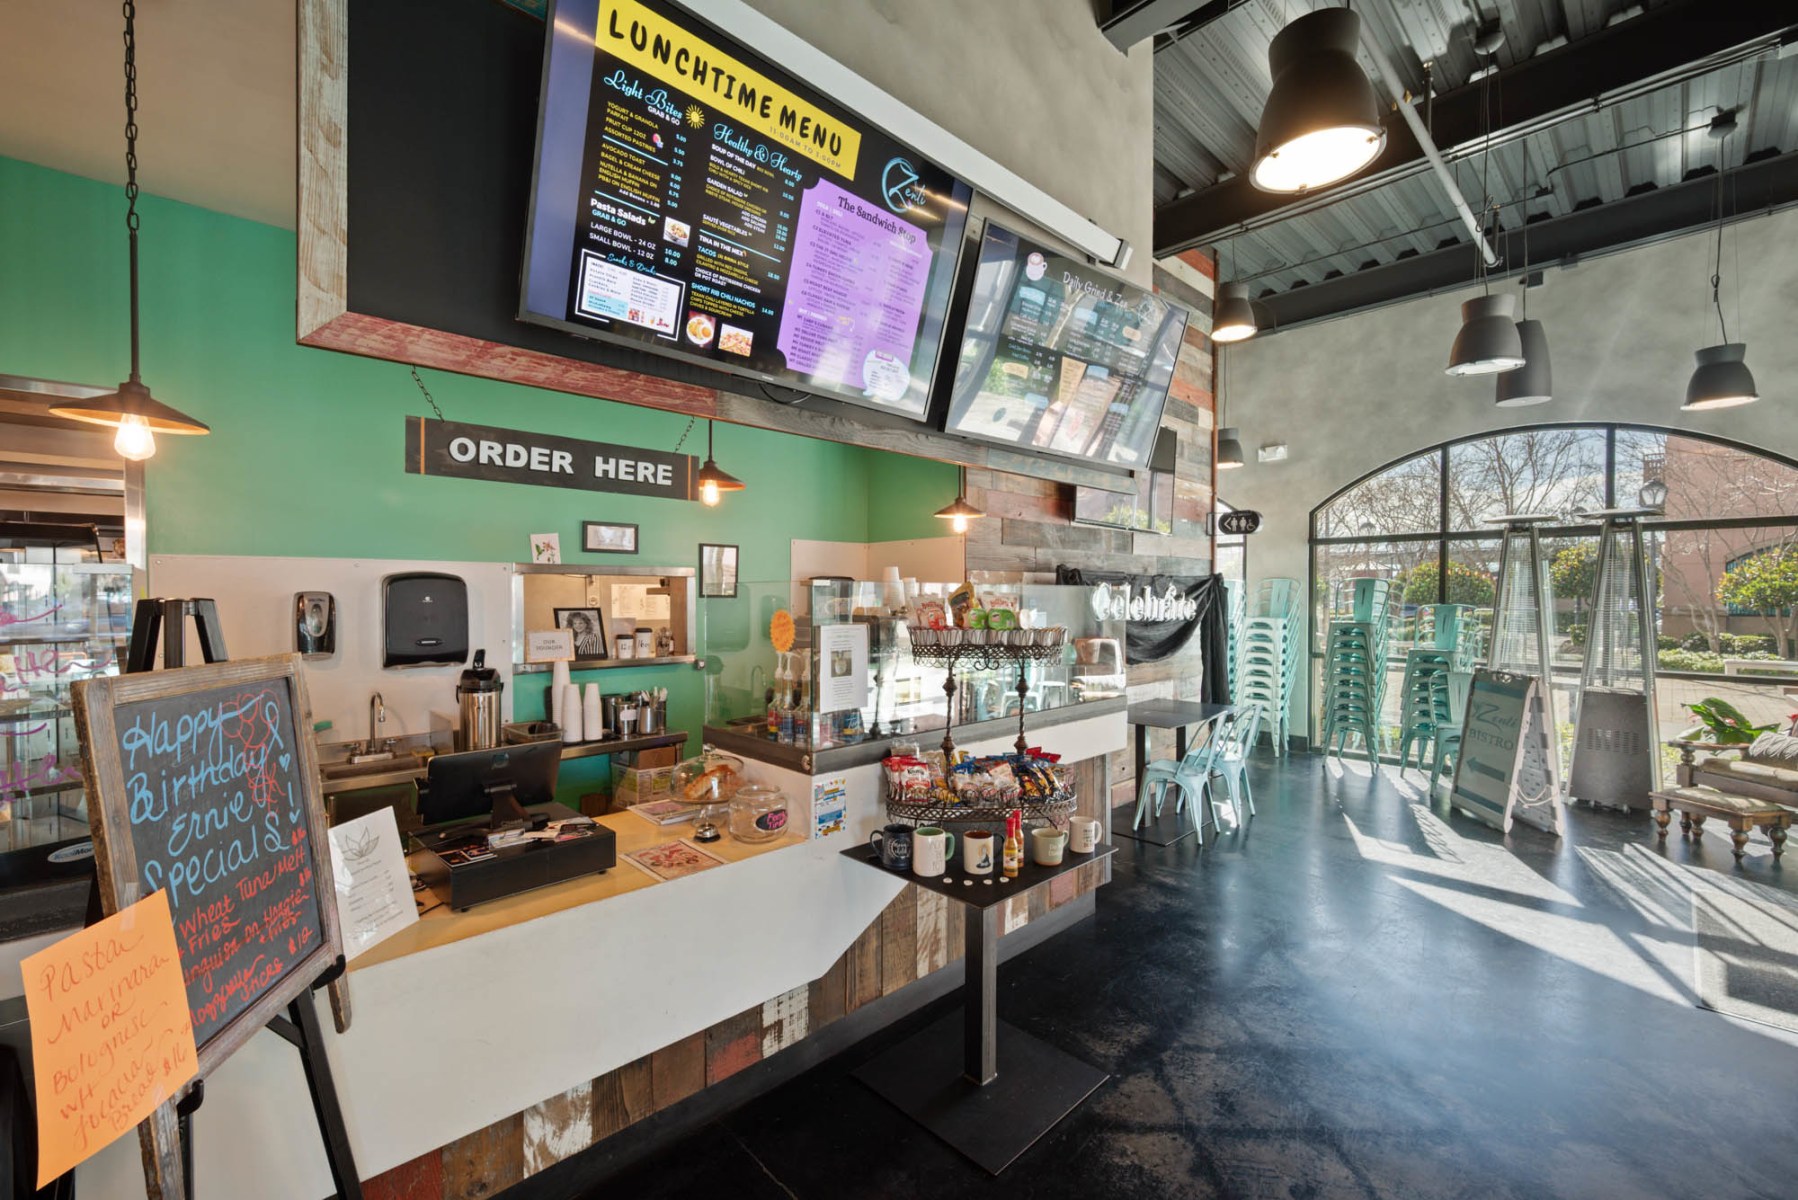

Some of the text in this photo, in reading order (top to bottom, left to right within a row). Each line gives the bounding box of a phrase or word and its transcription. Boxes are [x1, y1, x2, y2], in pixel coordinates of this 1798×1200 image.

[604, 69, 683, 119] Light Bites
[609, 9, 842, 157] LUNCHTIME MENU
[606, 117, 621, 128] FRUIT
[622, 124, 632, 133] CUP
[607, 108, 629, 122] PARFAIT
[608, 101, 629, 116] YOGURT
[635, 114, 658, 129] GRANOLA
[648, 105, 665, 118] GRAB
[671, 117, 680, 126] GO
[604, 126, 656, 153] ASSORTED PASTRIES
[713, 123, 803, 182] Healthy & Hearty
[805, 142, 814, 155] TO
[601, 152, 618, 163] BAGEL
[624, 161, 641, 172] CREAM
[642, 169, 660, 181] CHEESE
[602, 142, 645, 165] AVOCADO TOAST
[710, 154, 726, 166] BOWL
[733, 165, 745, 175] CHILI
[712, 143, 756, 169] SOUP OF THE DAY
[599, 167, 640, 187] ENGLISH MUFFIN
[600, 161, 622, 174] NUTELLA
[628, 173, 649, 185] BANANA
[621, 183, 641, 195] ENGLISH
[642, 192, 660, 203] MUFFIN
[707, 177, 743, 197] GARDEN SALAD
[590, 198, 646, 225] Pasta Salads
[592, 209, 610, 220] GRAB
[617, 218, 626, 226] GO
[837, 195, 856, 214] The
[856, 205, 898, 234] Sandwich
[897, 226, 917, 245] Stop
[591, 221, 656, 250] LARGE BOWL 24 OZ
[720, 221, 748, 236] VEGETABLES
[589, 232, 611, 244] SMALL
[612, 240, 632, 252] BOWL
[646, 252, 654, 260] OZ
[698, 246, 716, 257] TACOS
[699, 235, 713, 245] TINA
[720, 243, 731, 252] THE
[732, 247, 744, 256] MEX
[695, 267, 711, 276] CHOICE
[712, 278, 726, 286] ROAST
[691, 282, 710, 293] SHORT
[720, 292, 734, 301] CHILI
[734, 296, 756, 308] NACHOS
[1063, 271, 1113, 302] Daily Grind &
[448, 437, 673, 486] ORDER HERE
[1091, 582, 1196, 622] Celebrate
[123, 697, 246, 770] Happy
[1469, 728, 1514, 751] BISTRO
[127, 743, 268, 825] Birthday
[168, 790, 253, 857] Ernie
[180, 894, 235, 939] Wheat
[235, 864, 277, 902] Tuna
[278, 845, 305, 878] Melt
[188, 915, 242, 957] Fries
[40, 934, 138, 1001] Pasta
[184, 940, 240, 994] inguisa
